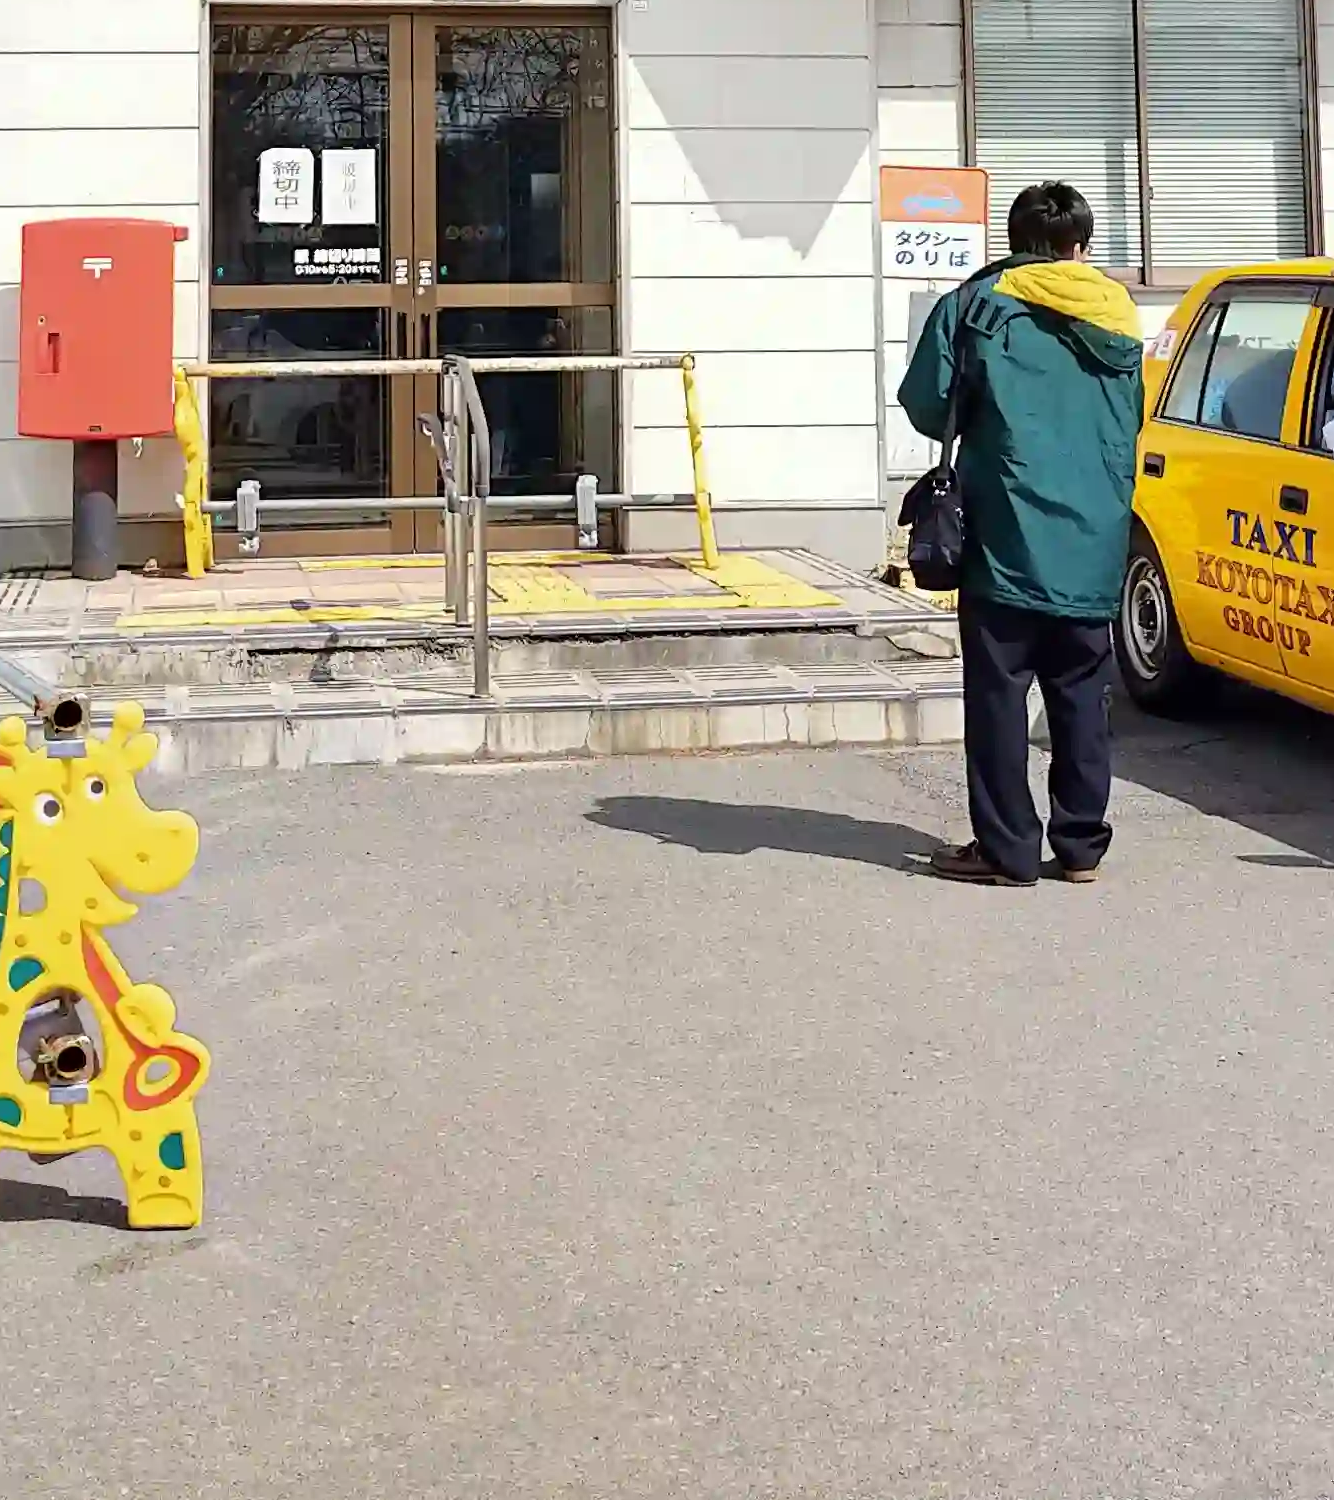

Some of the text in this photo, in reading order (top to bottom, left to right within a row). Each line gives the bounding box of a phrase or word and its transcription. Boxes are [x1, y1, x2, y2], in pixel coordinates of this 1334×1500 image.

[272, 160, 301, 209] 締切中
[895, 230, 969, 247] タクシー
[895, 250, 971, 267] のりば
[1226, 508, 1318, 568] TAXI
[1223, 605, 1313, 657] GROUP
